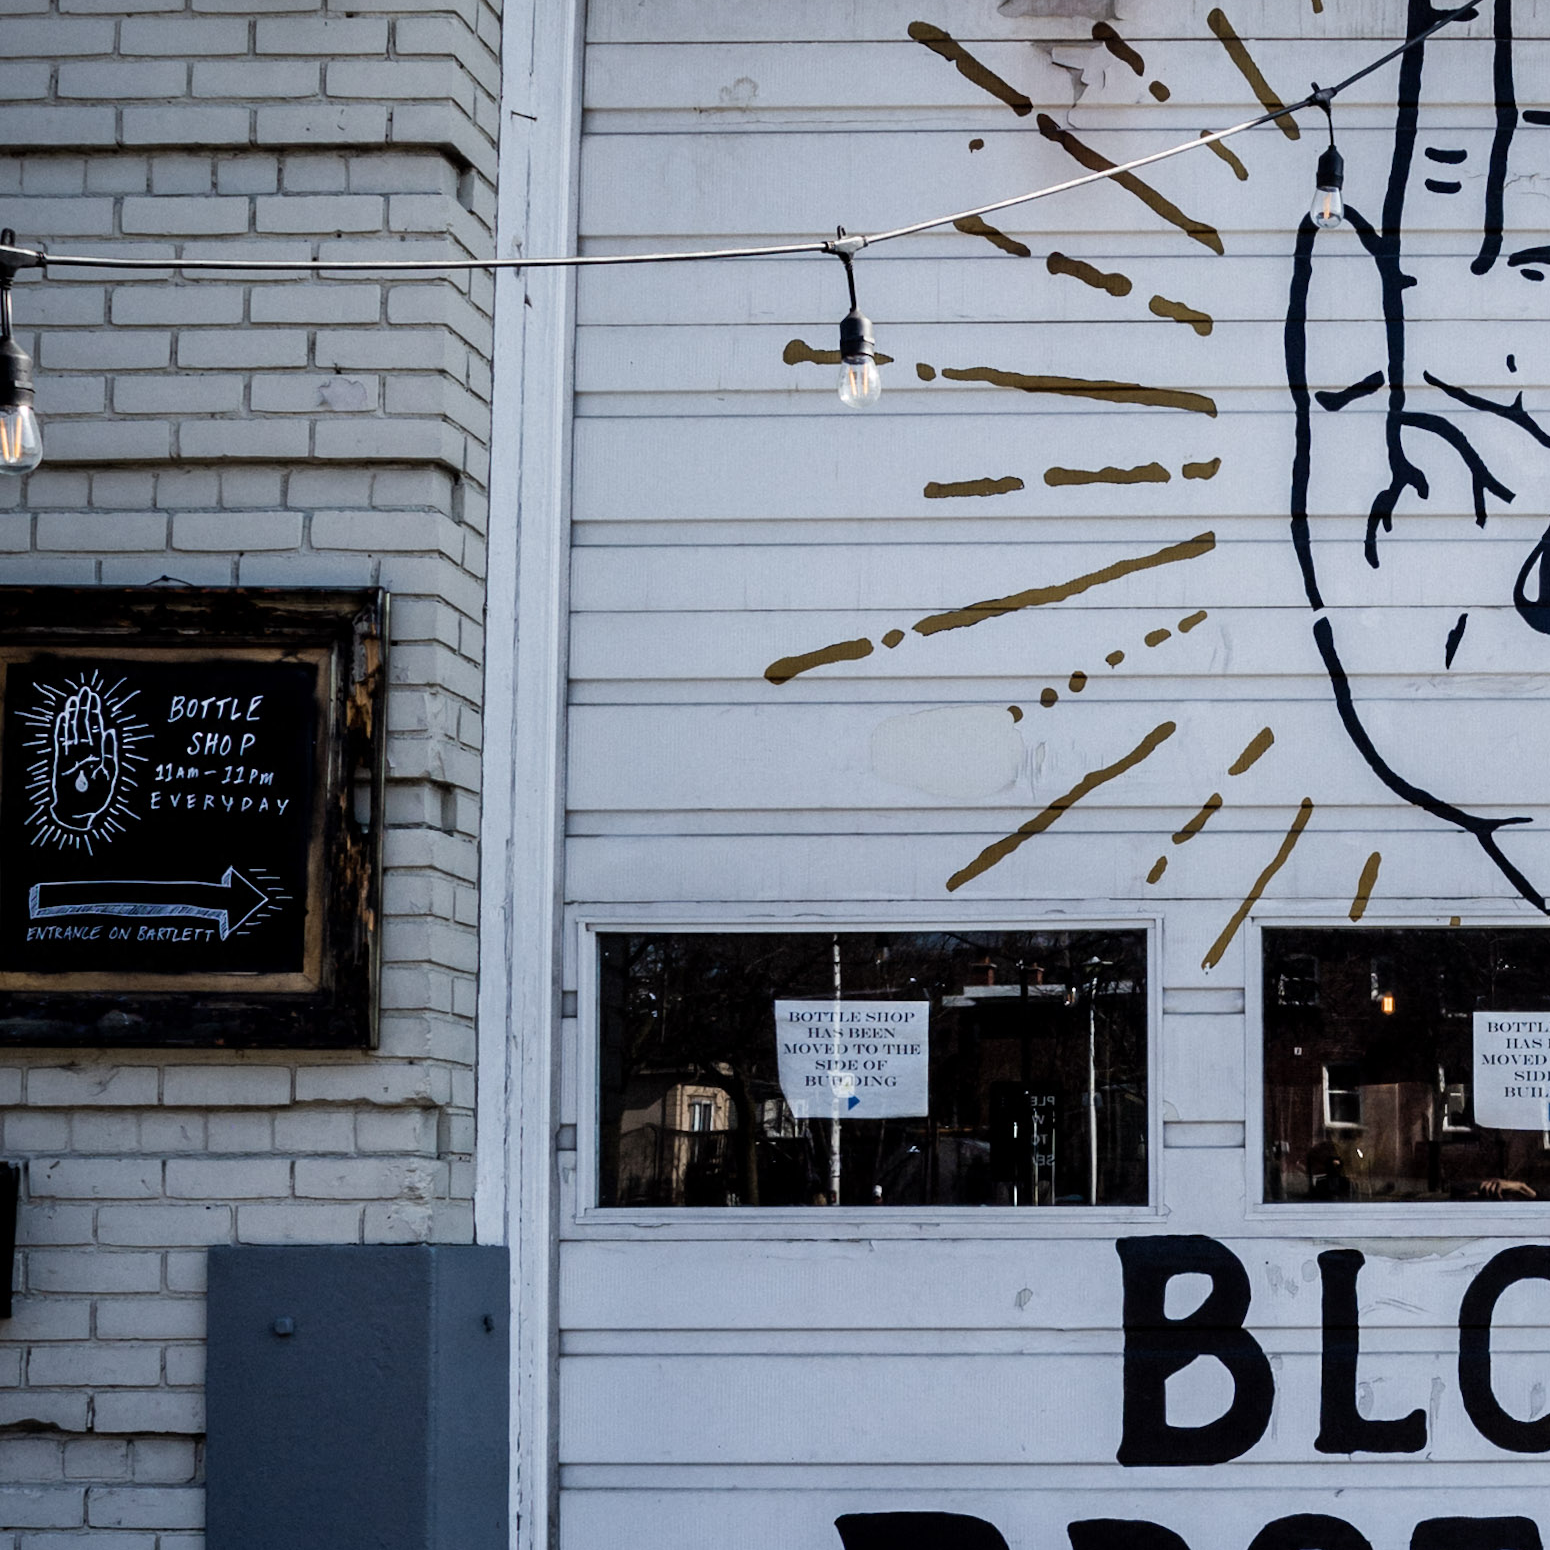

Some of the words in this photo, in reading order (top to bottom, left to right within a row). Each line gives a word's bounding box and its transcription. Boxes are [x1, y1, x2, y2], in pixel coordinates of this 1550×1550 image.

[167, 695, 264, 722] BOTTLE
[187, 732, 256, 756] SHOP
[150, 791, 289, 815] EVERYDAY
[27, 925, 104, 942] ENTRANCE
[108, 925, 130, 940] ON
[136, 926, 215, 942] BARTLETT
[789, 1011, 861, 1023] BOTTLE
[865, 1011, 915, 1022] SHOP
[808, 1027, 843, 1038] HAS
[849, 1027, 896, 1038] BEEN
[784, 1043, 848, 1055] MOVED
[853, 1044, 878, 1055] TO
[883, 1044, 921, 1055] THE
[1506, 1038, 1543, 1049] HAS
[815, 1060, 858, 1071] SIDE
[863, 1060, 888, 1071] OF
[1482, 1054, 1547, 1065] MOVED
